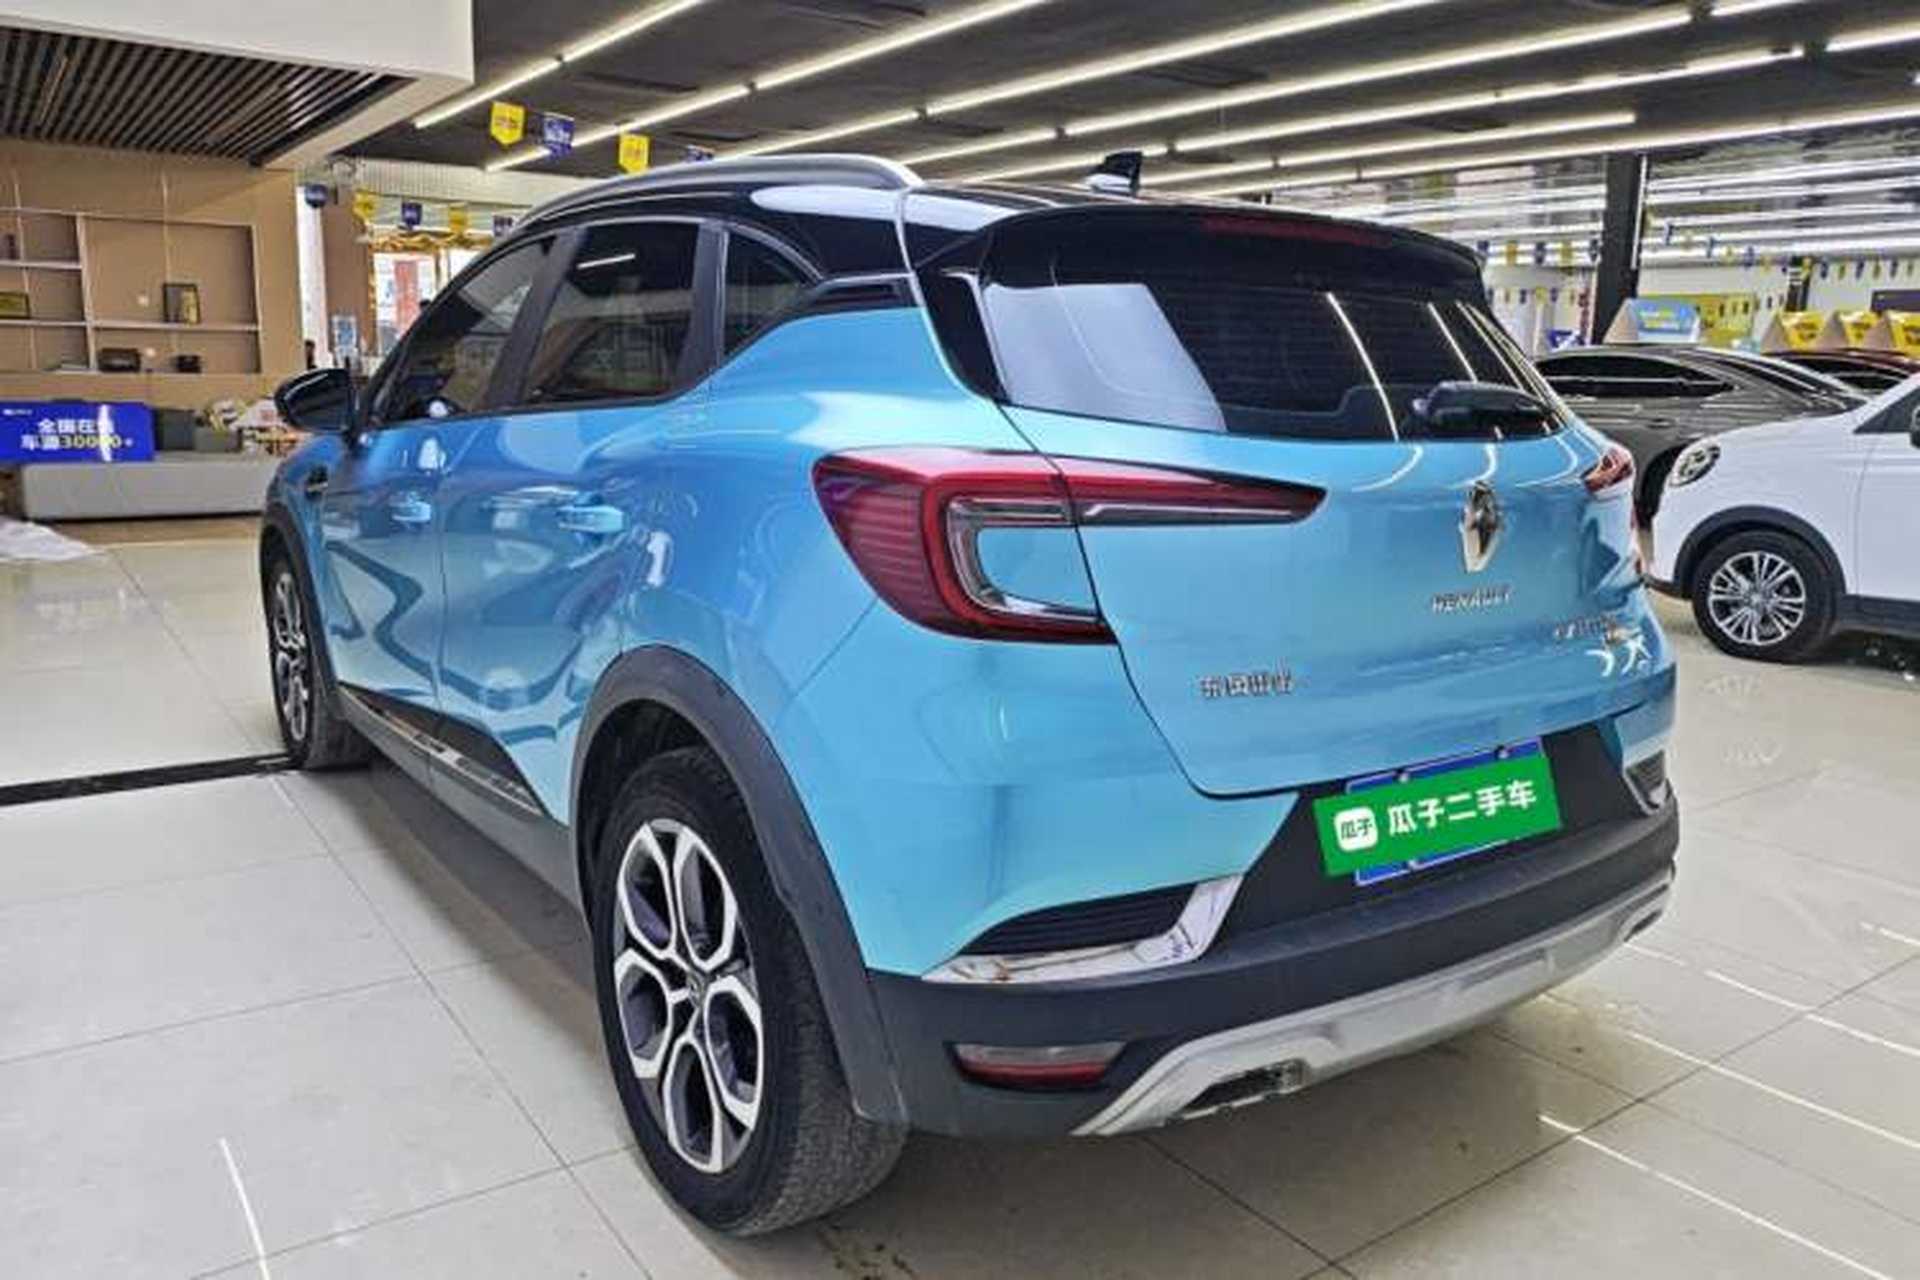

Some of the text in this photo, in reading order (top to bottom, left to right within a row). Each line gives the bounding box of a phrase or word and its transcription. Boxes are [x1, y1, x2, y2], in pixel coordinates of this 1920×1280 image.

[1431, 584, 1512, 611] RENAULT
[1387, 779, 1538, 836] 瓜子二手车
[1340, 817, 1373, 839] 瓜子
